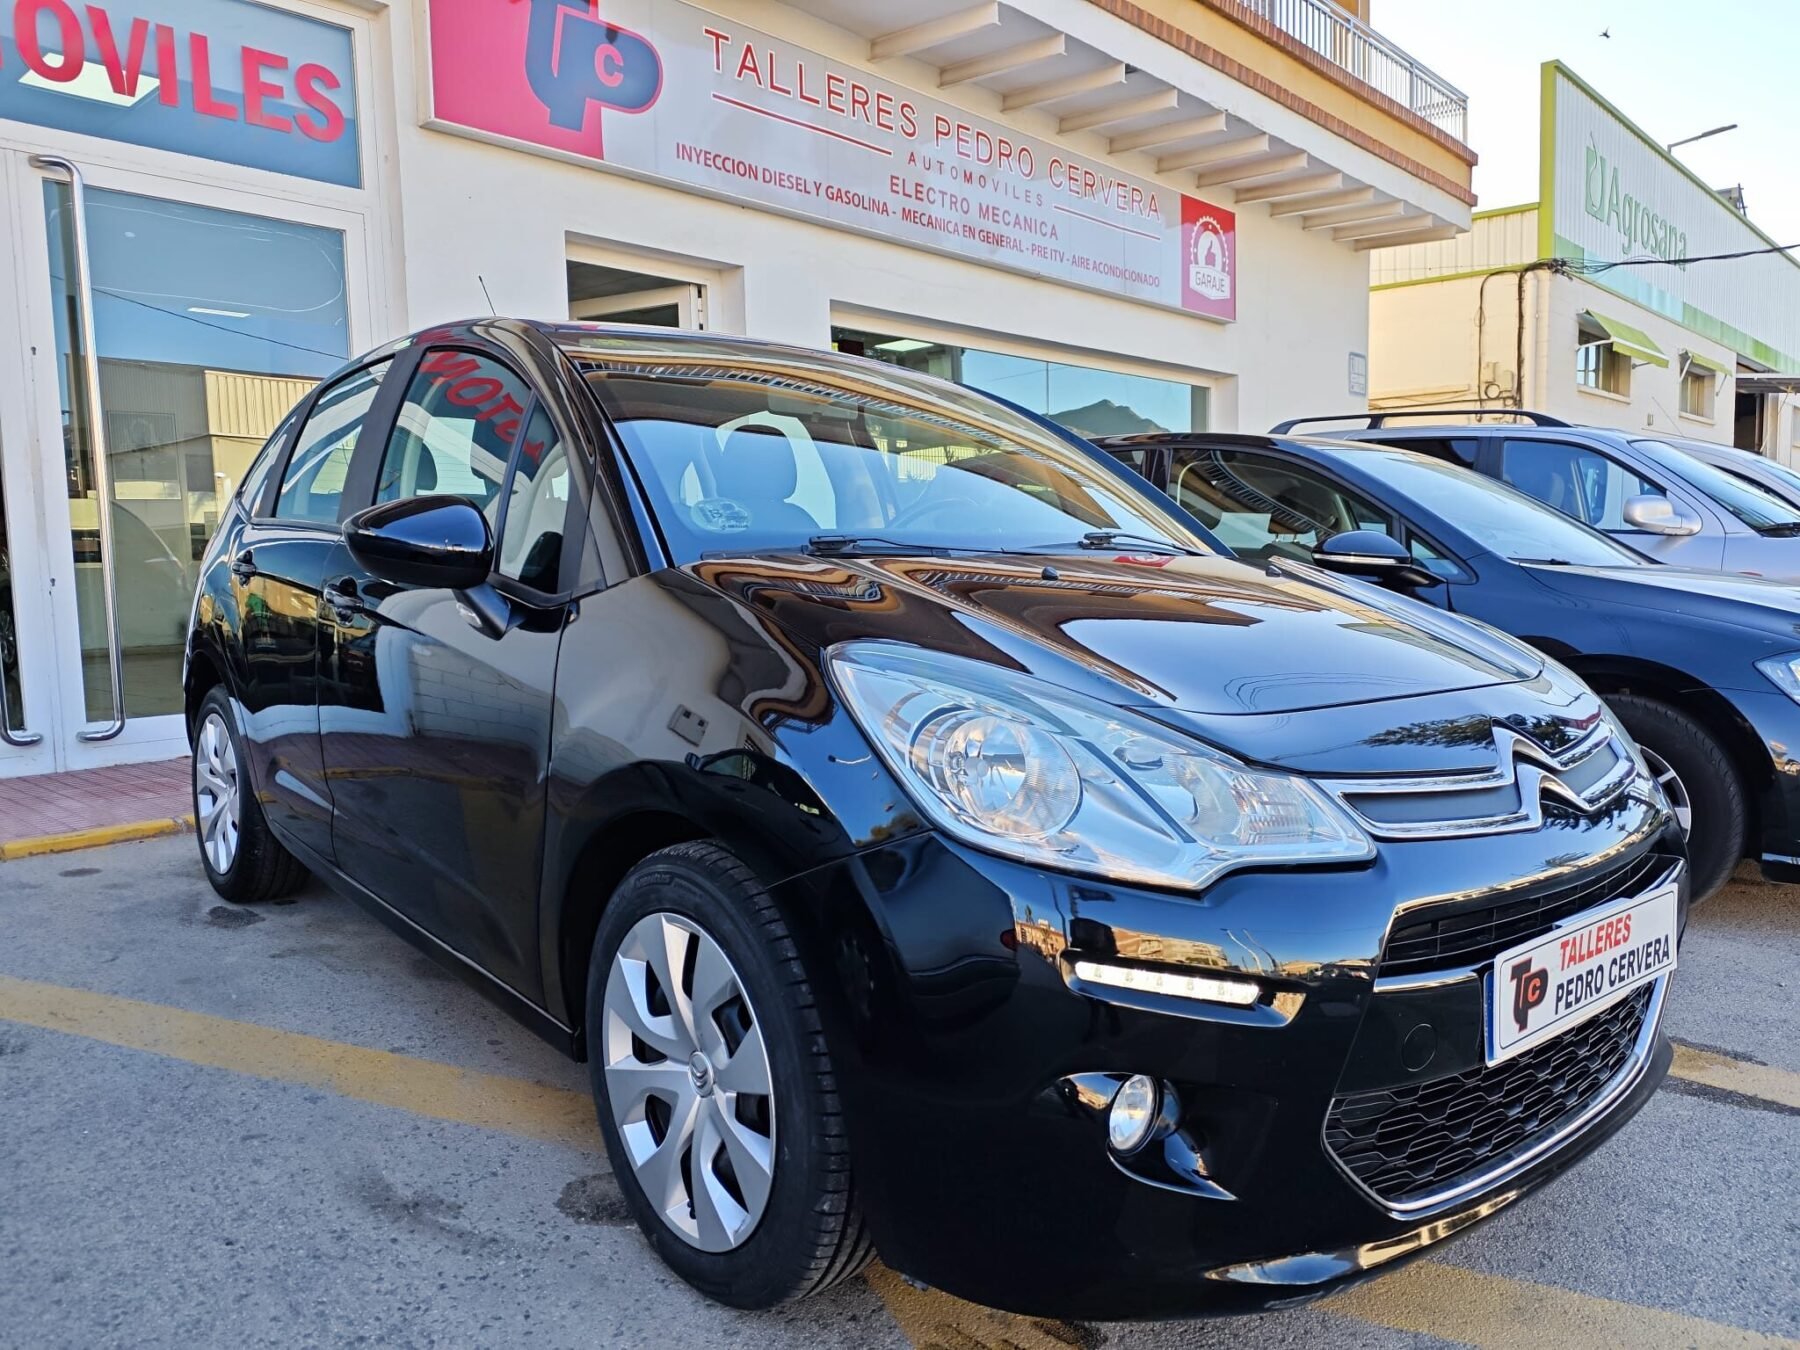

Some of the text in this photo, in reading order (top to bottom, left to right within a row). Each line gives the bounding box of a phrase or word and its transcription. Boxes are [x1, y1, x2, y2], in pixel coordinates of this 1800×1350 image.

[0, 0, 345, 144] OVILES
[703, 26, 1161, 220] TALLERES PEDRO CERVERA
[675, 141, 759, 181] INYECCION
[762, 167, 811, 195] DIESEL
[813, 181, 822, 197] Y
[825, 185, 890, 217] GASOLINA
[901, 207, 960, 236] MECANICA
[962, 224, 976, 240] EN
[978, 228, 1024, 253] GENERAL
[1031, 243, 1049, 260] PRE
[1050, 247, 1065, 264] ITV
[1071, 254, 1091, 271] AIRE
[1092, 260, 1161, 288] ACONDICIONADO
[890, 174, 1059, 241] ELECTRO MECANICA
[907, 151, 1043, 207] AUTOMOVILES
[1606, 166, 1687, 273] Agrosana
[1195, 271, 1226, 293] GARAJE
[1554, 934, 1670, 1015] PEDRO CERVERA
[1559, 913, 1632, 972] TALLERES
